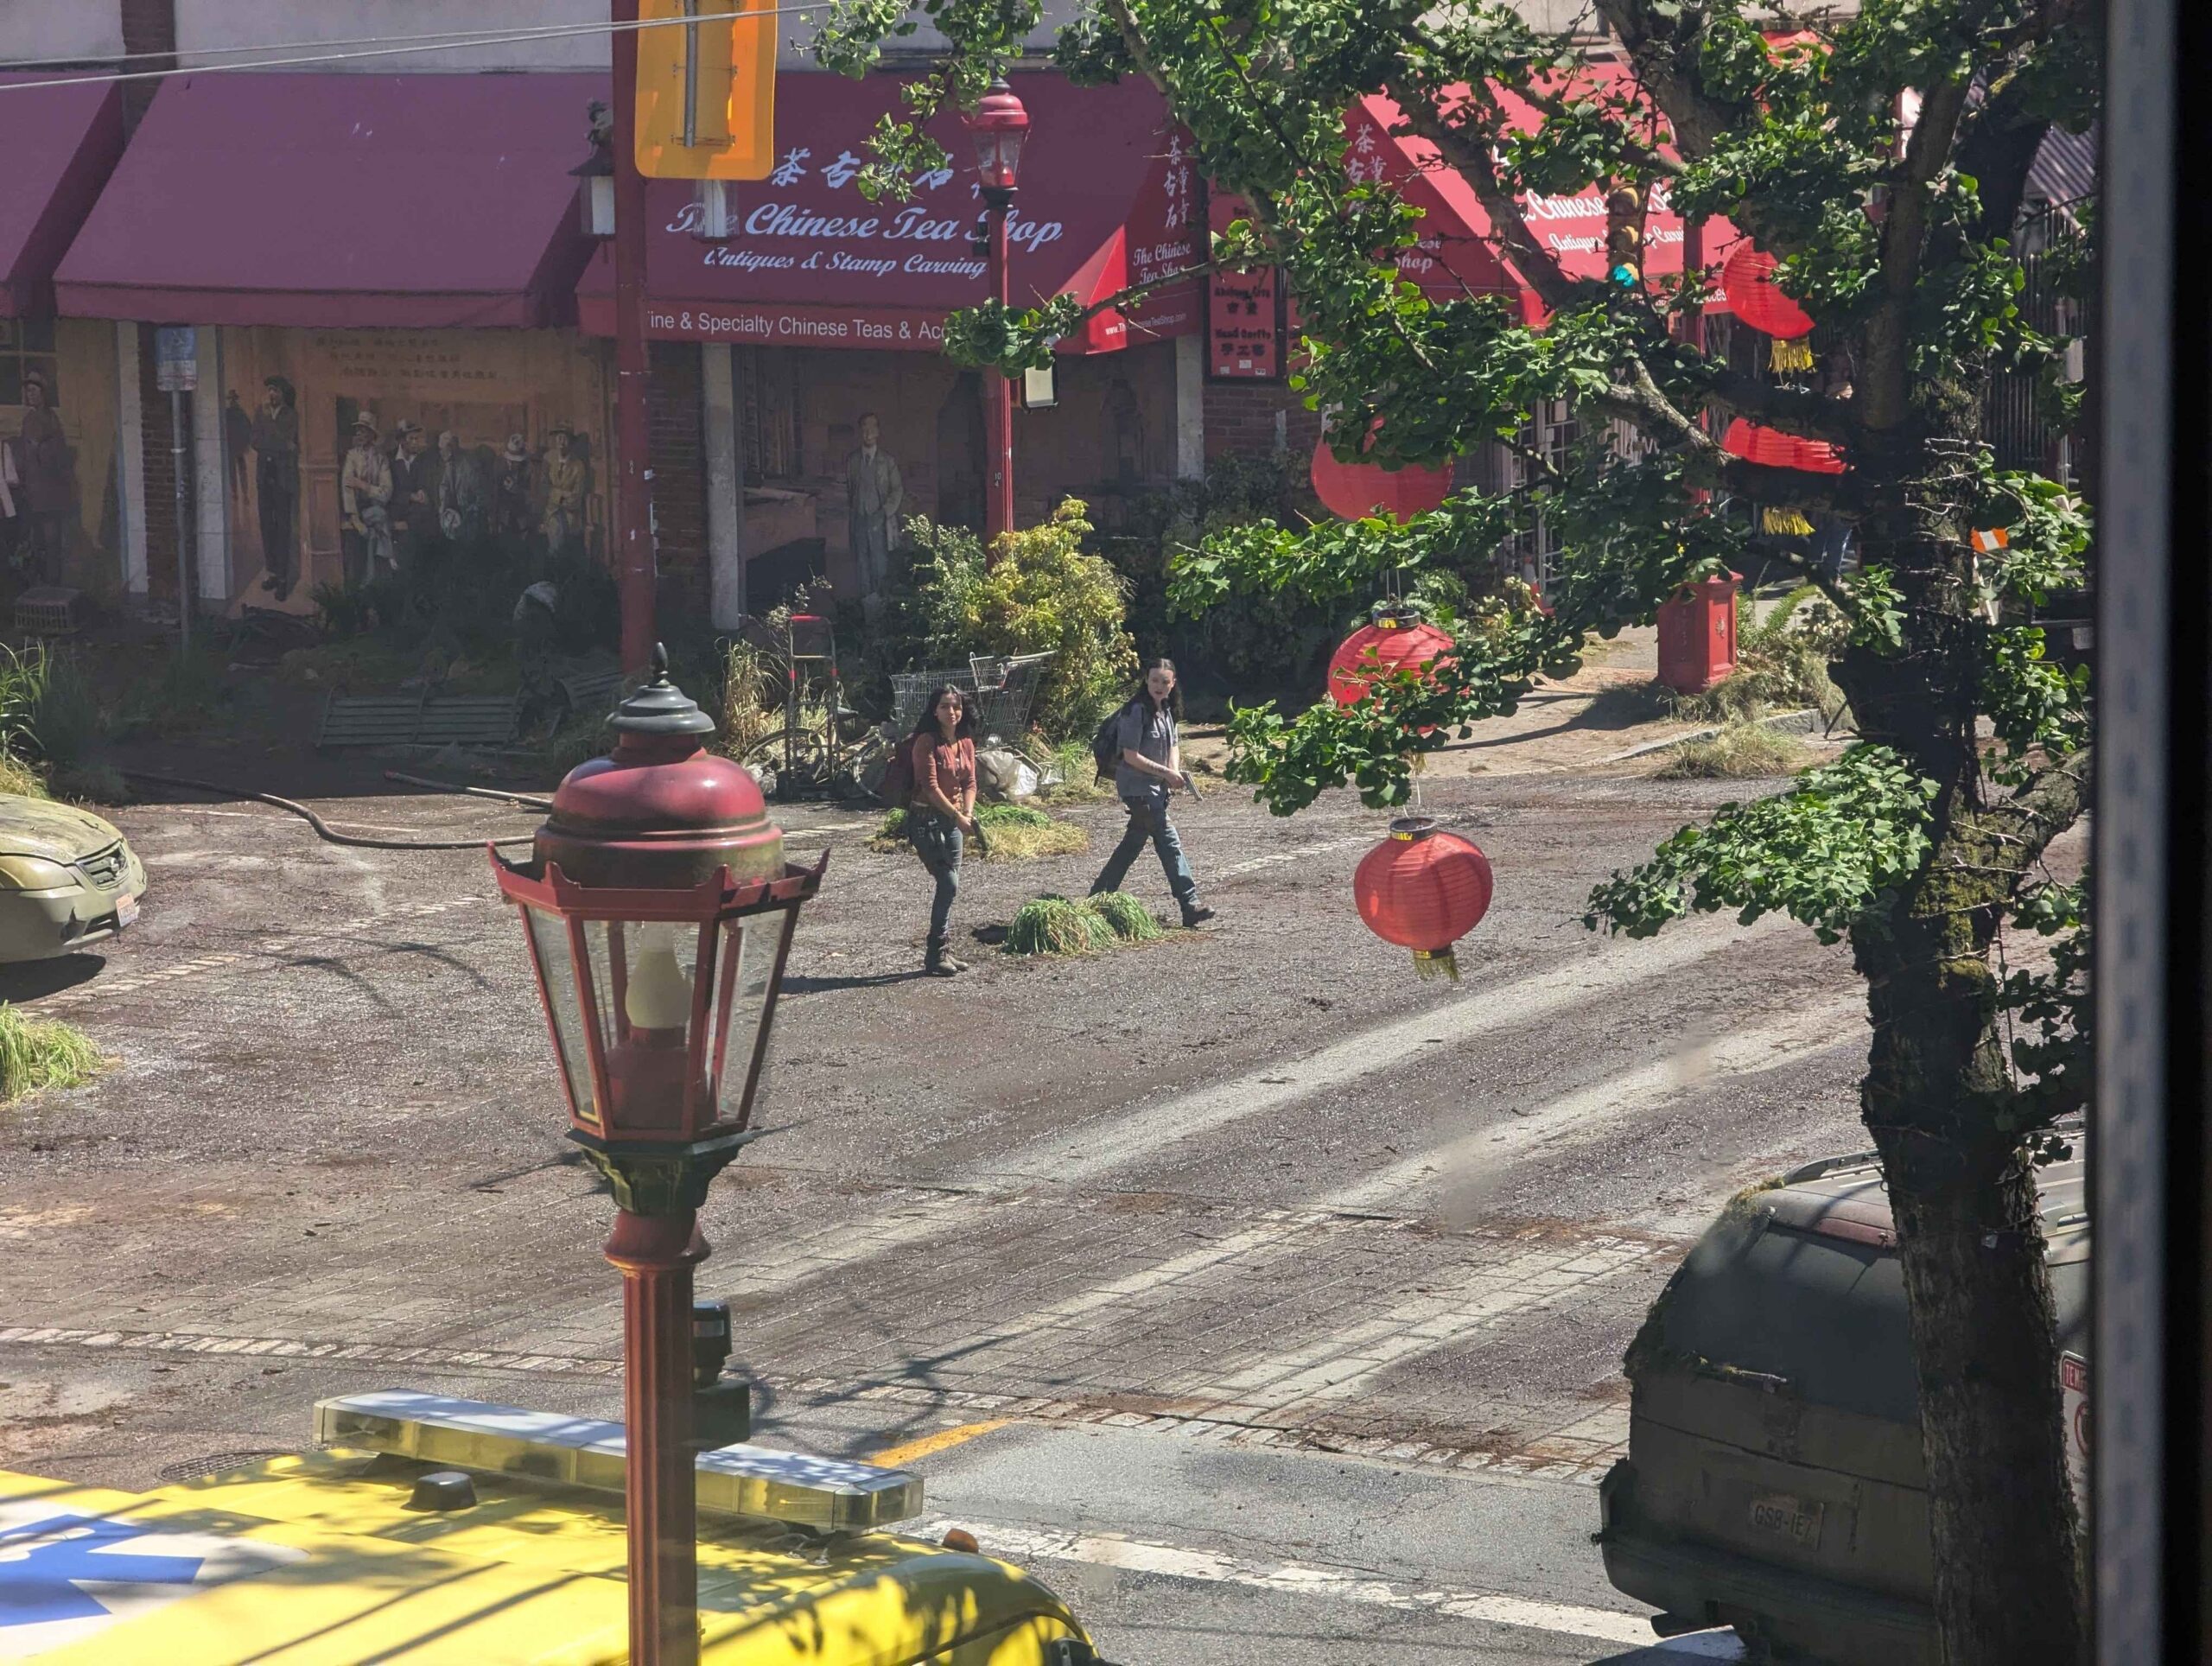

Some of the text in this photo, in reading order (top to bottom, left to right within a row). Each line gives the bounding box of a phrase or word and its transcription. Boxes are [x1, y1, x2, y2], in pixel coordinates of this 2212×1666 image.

[745, 203, 880, 238] Chinese
[883, 207, 960, 240] Tea
[1133, 243, 1191, 266] The Chinese
[1548, 232, 1605, 254] Antiques
[704, 246, 988, 280] Antiques & Stamp Carving
[648, 310, 675, 329] ine
[680, 312, 693, 330] &
[698, 312, 773, 337] Specialty
[779, 316, 848, 336] Chinese
[853, 319, 893, 339] Teas
[899, 321, 911, 340] &
